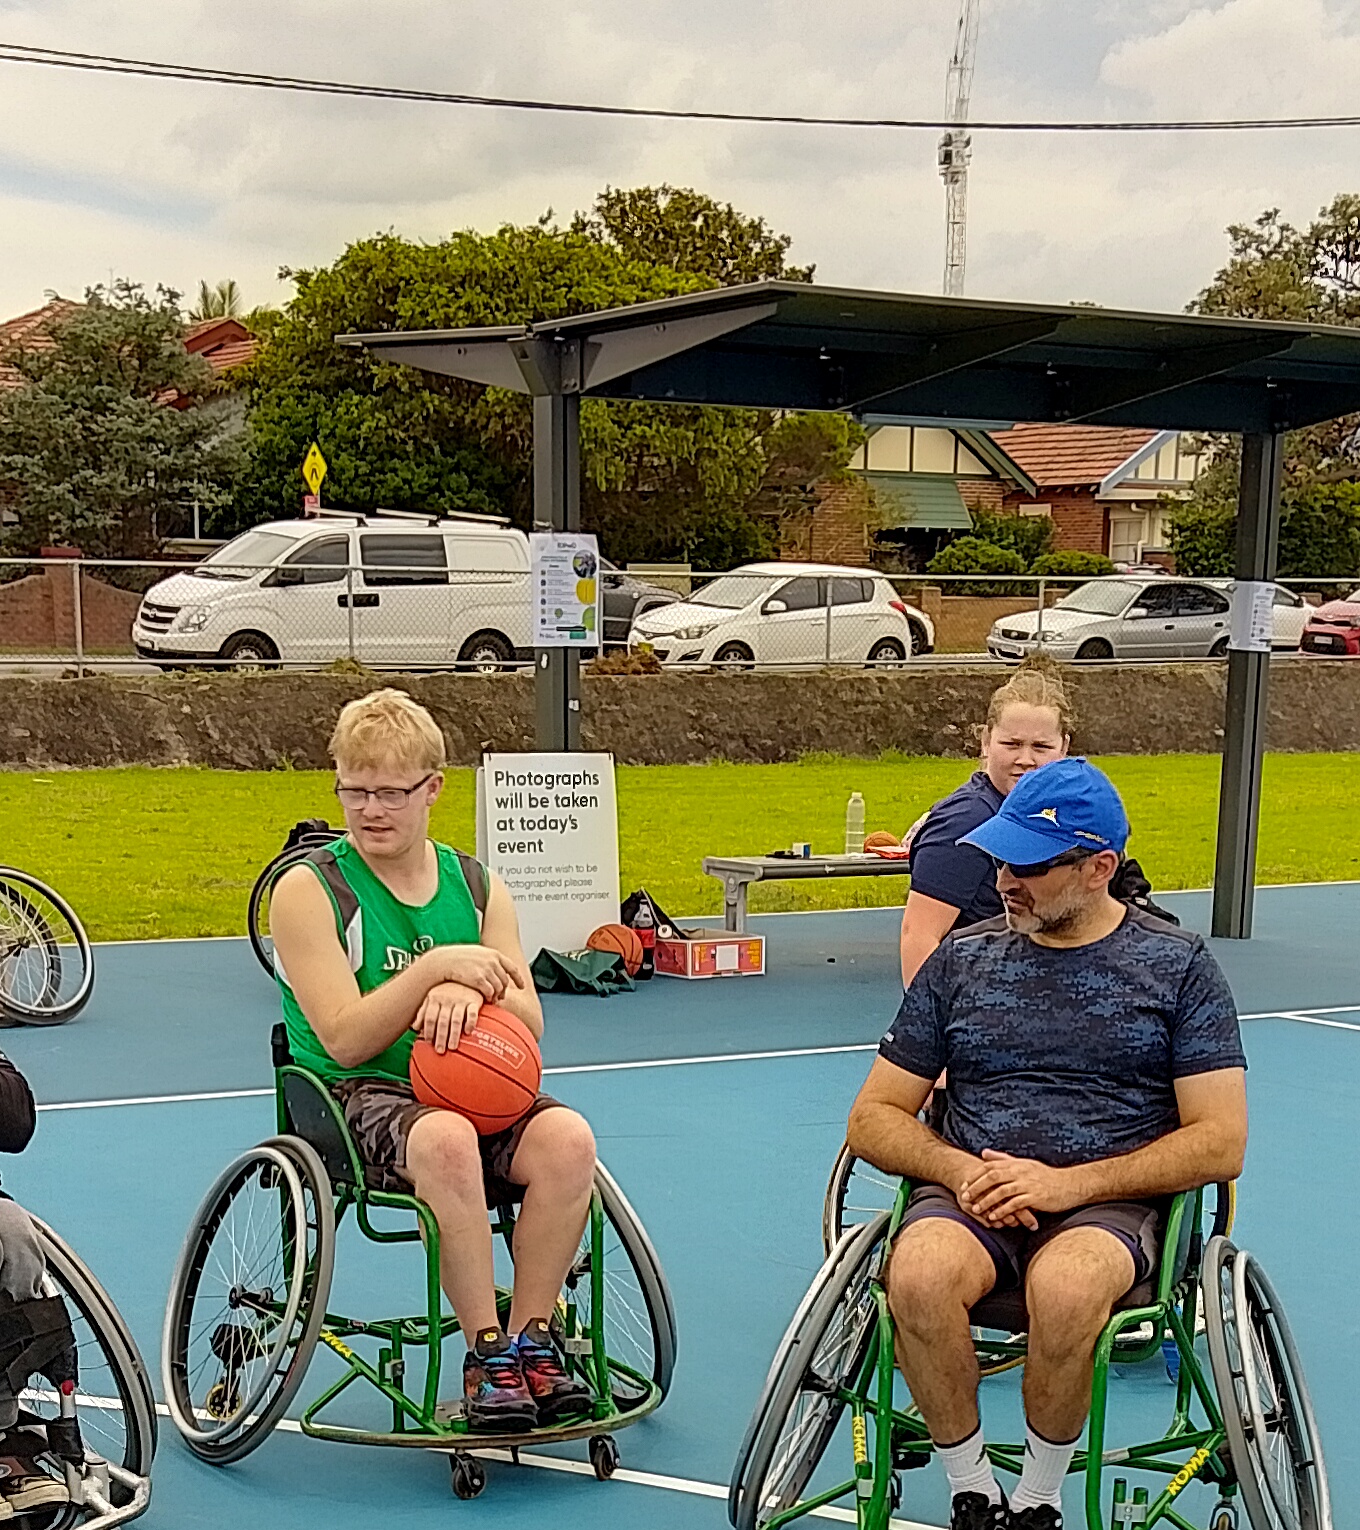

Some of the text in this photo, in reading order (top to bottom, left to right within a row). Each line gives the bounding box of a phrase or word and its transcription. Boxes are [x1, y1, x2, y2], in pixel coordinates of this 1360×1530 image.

[494, 769, 600, 790] Photographs
[495, 791, 599, 809] will be taken
[496, 814, 578, 834] at today's
[497, 838, 544, 853] event
[497, 863, 598, 876] If you do not wish to be
[504, 878, 593, 890] hotographed please
[528, 892, 543, 901] the
[544, 892, 569, 902] event
[1167, 1448, 1210, 1496] ROMA
